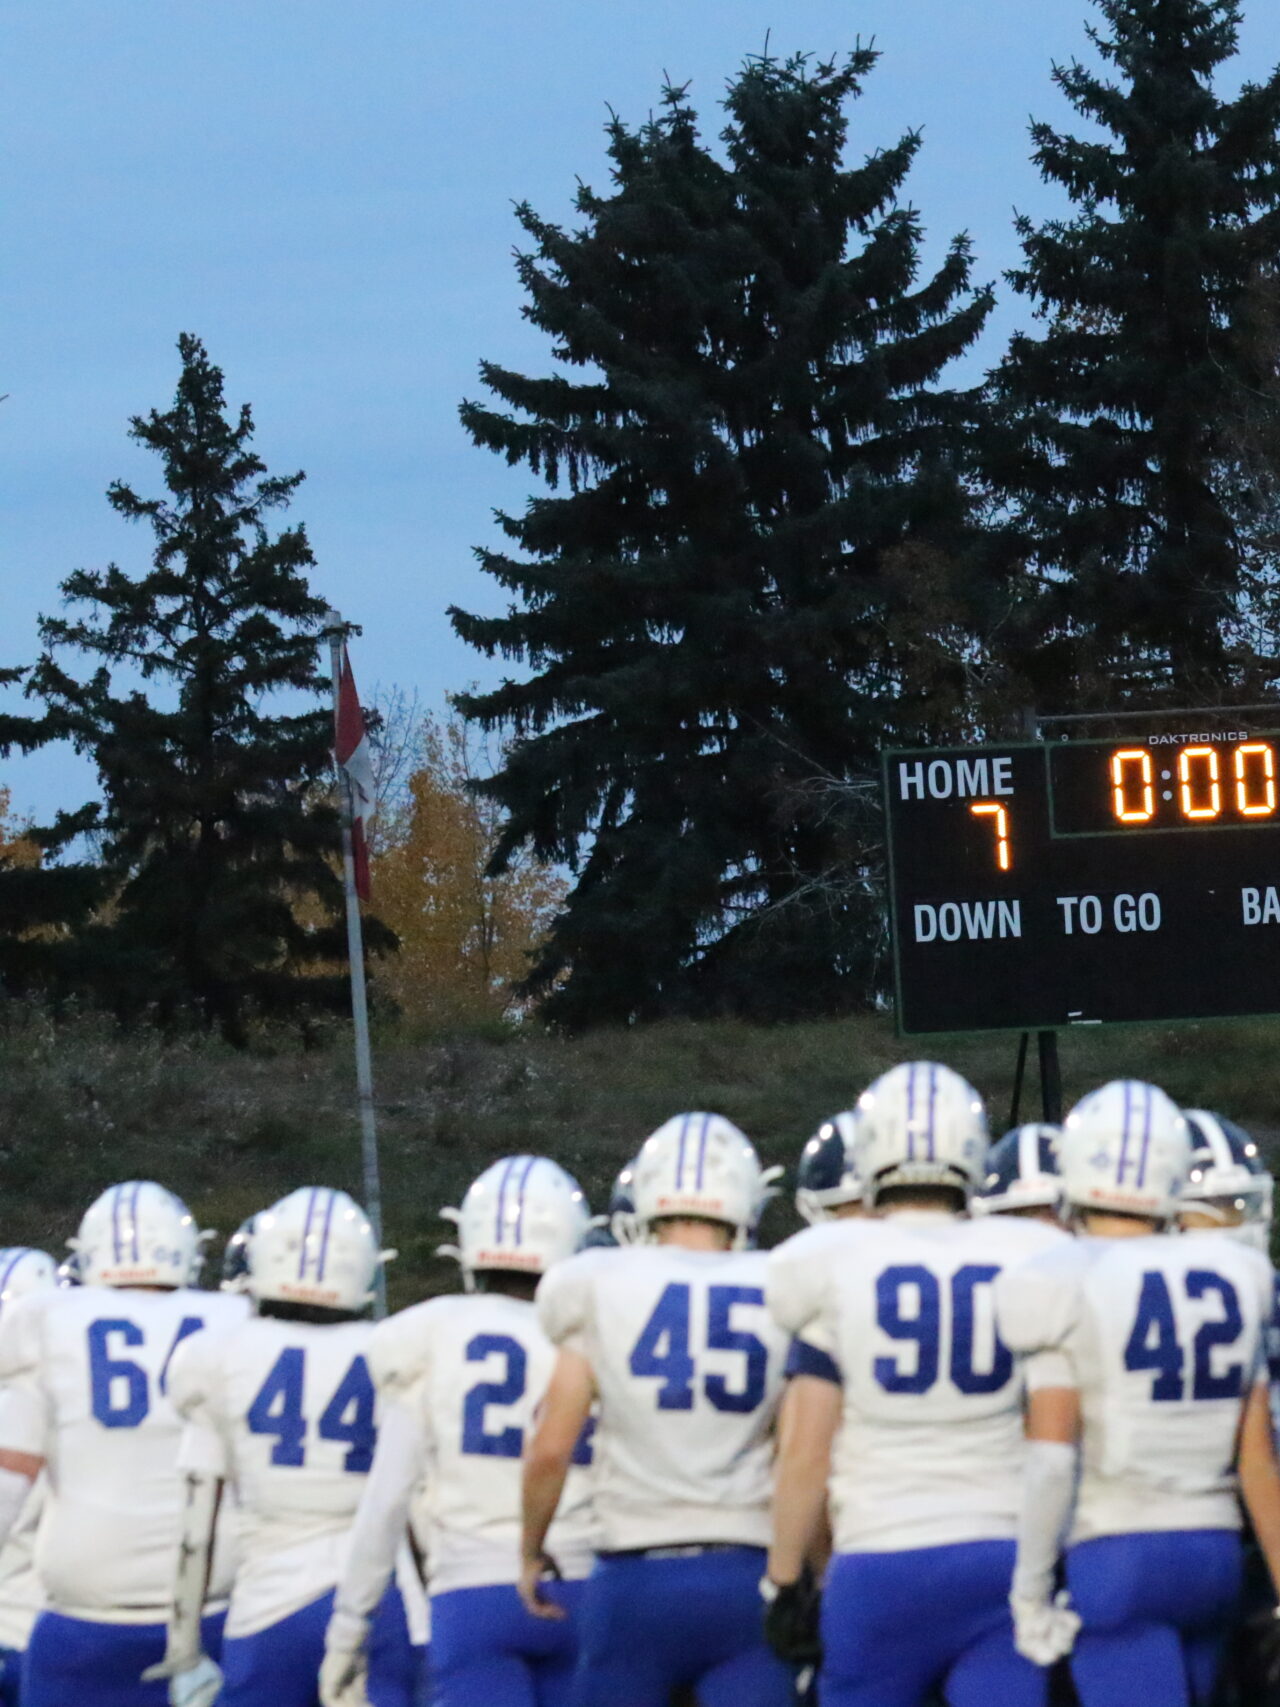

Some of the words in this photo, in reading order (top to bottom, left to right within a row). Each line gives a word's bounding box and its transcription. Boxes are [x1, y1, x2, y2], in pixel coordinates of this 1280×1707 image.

[1149, 731, 1248, 745] DAKTRONICS
[900, 758, 1014, 799] HOME
[971, 802, 1009, 870] 7
[914, 901, 1022, 943] DOWN
[1057, 896, 1102, 934] TO
[1114, 893, 1161, 933] GO
[629, 1282, 768, 1413] 45
[874, 1265, 1012, 1395] 90
[1125, 1270, 1243, 1401] 42
[247, 1347, 377, 1473] 44
